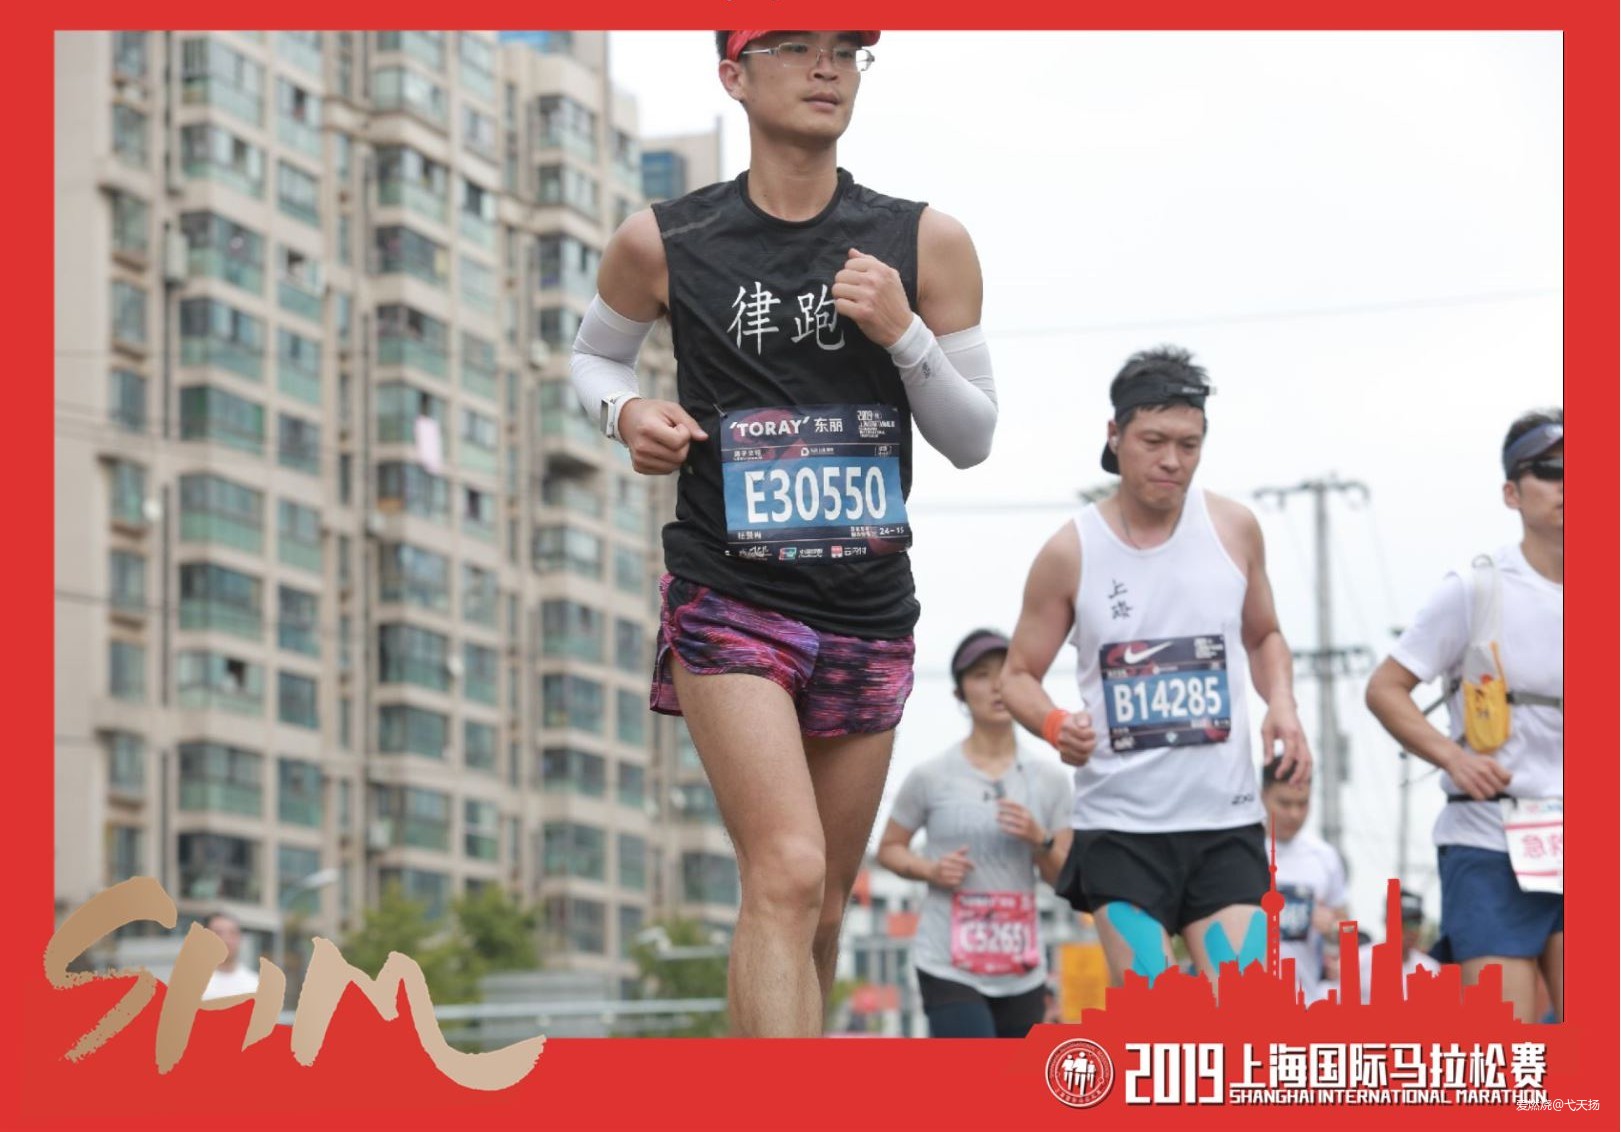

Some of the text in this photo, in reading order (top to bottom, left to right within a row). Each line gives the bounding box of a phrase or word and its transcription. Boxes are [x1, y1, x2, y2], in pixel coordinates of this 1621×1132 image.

[727, 281, 845, 355] 律跑
[814, 417, 843, 433] 东丽
[744, 466, 887, 524] E30550
[1112, 676, 1222, 724] B14285
